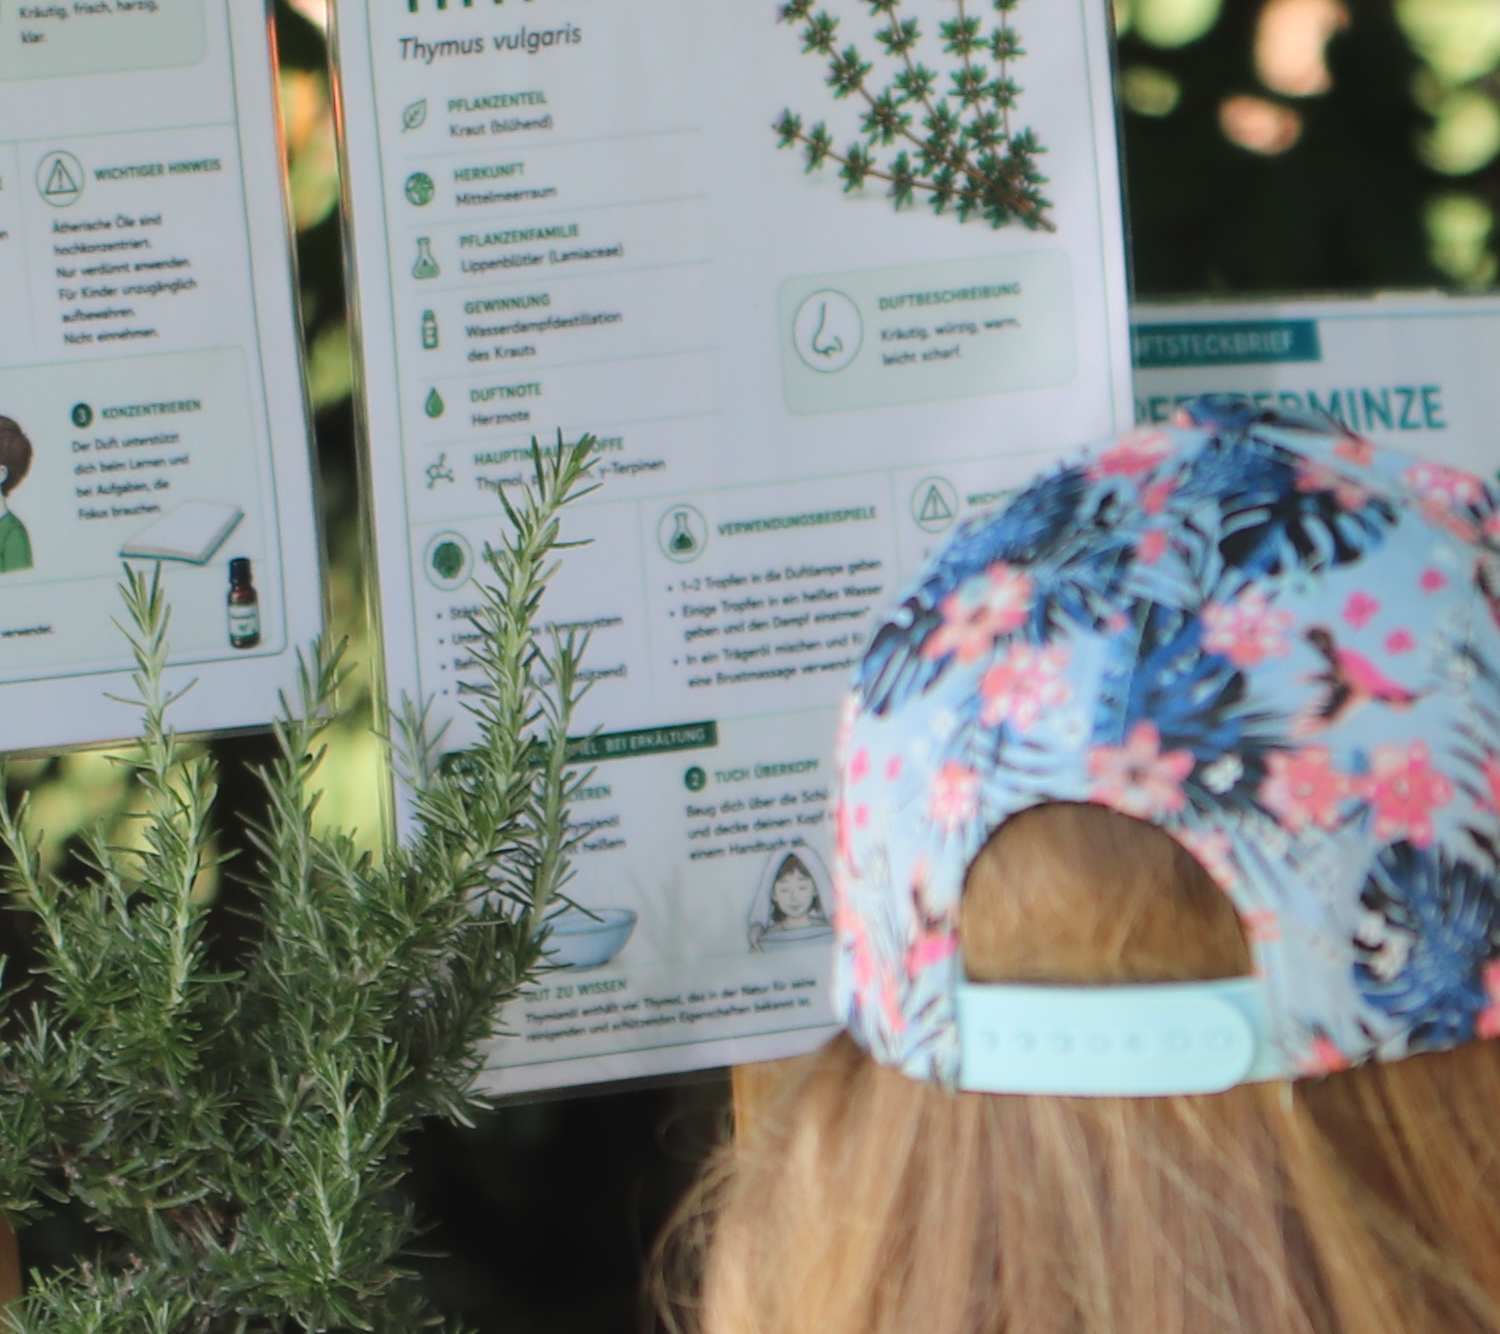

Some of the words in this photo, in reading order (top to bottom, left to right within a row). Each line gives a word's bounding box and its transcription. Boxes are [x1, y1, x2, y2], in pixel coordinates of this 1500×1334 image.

[398, 29, 485, 67] Thymus
[492, 20, 582, 58] vulgaris
[447, 89, 547, 114] PFLANZENTEIL
[93, 163, 165, 182] WICHTIGER
[167, 157, 221, 175] HINWEIS
[453, 162, 525, 182] HERKUNFT
[459, 223, 578, 249] PFLANZENFAMILIE
[463, 292, 550, 315] GEWINNUNG
[877, 281, 1020, 311] DUFTBESCHREIBUNG
[469, 381, 541, 403] DUFTNOTE
[101, 398, 201, 420] KONZENTRIEREN
[717, 505, 875, 537] VERWENDUNGSBEISPIELE
[605, 736, 627, 753] BEI
[629, 726, 705, 750] ERKÄLTUNG
[714, 767, 750, 784] TUCH
[753, 757, 819, 779] ÜBERKOPF
